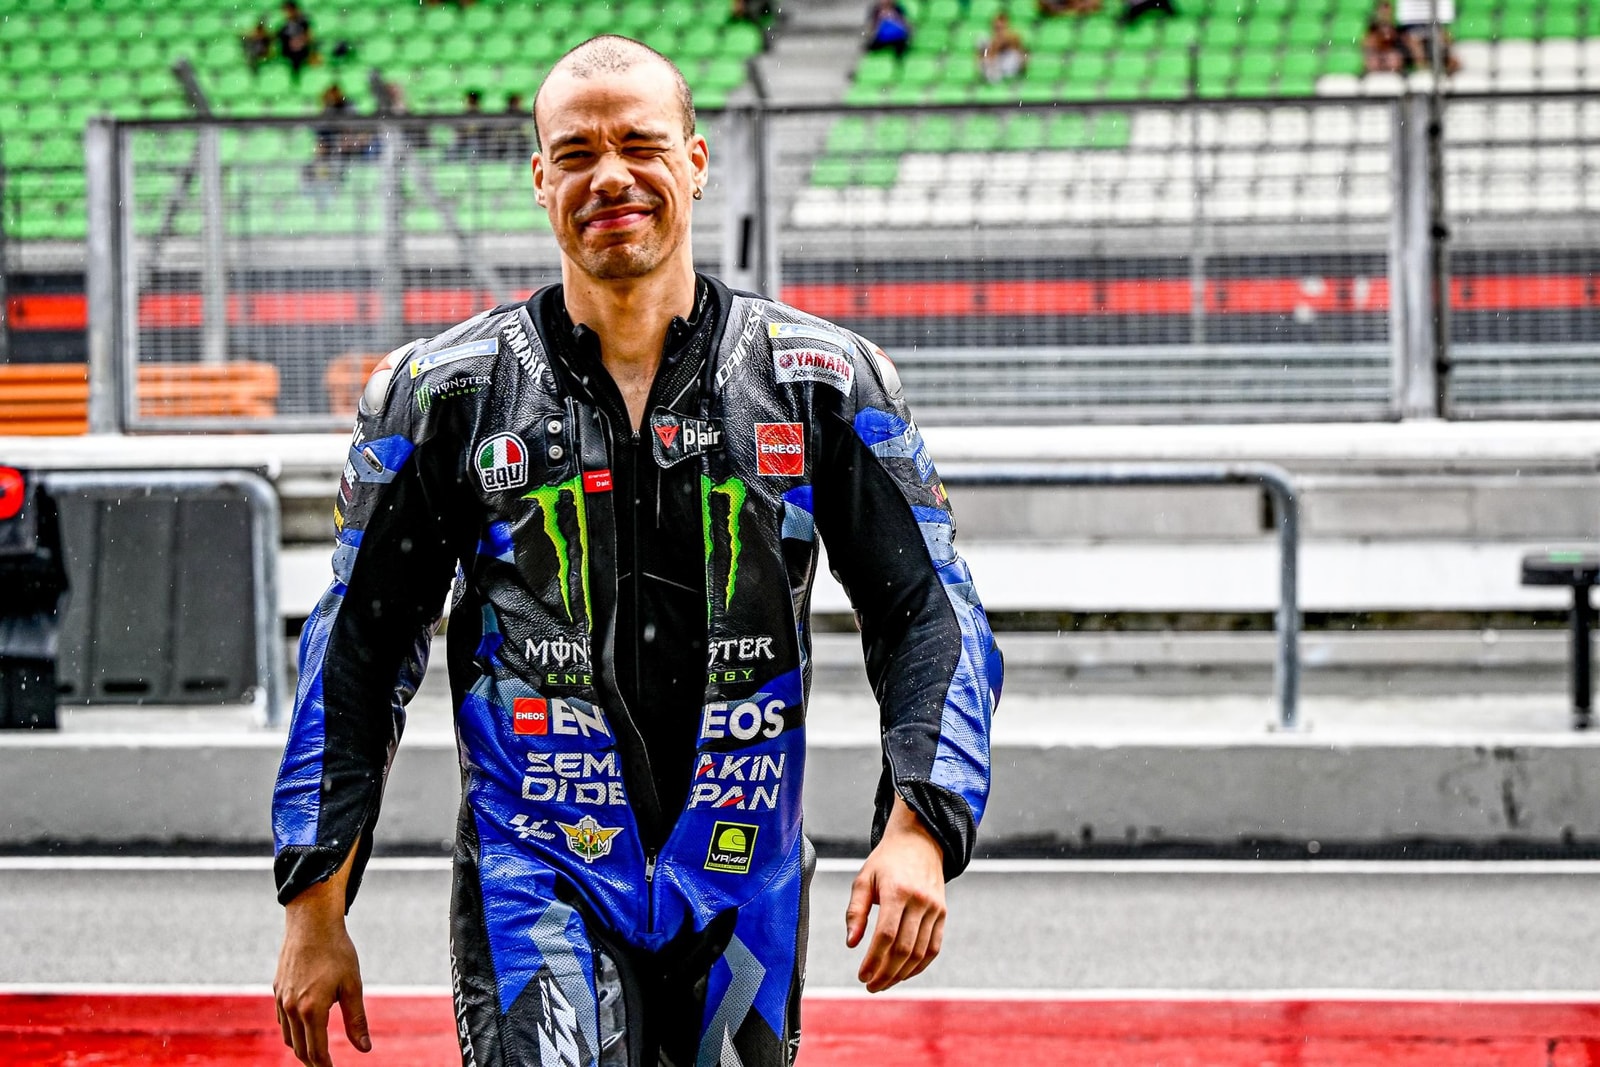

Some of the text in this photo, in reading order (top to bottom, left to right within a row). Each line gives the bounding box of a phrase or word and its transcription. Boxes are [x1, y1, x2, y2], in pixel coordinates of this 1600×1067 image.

[500, 311, 547, 385] YAMAHA
[715, 299, 765, 388] DAINESE
[796, 352, 850, 381] YAMAHA
[430, 376, 492, 396] MONSTER
[761, 444, 802, 454] ENEOS
[515, 712, 545, 720] ENEOS
